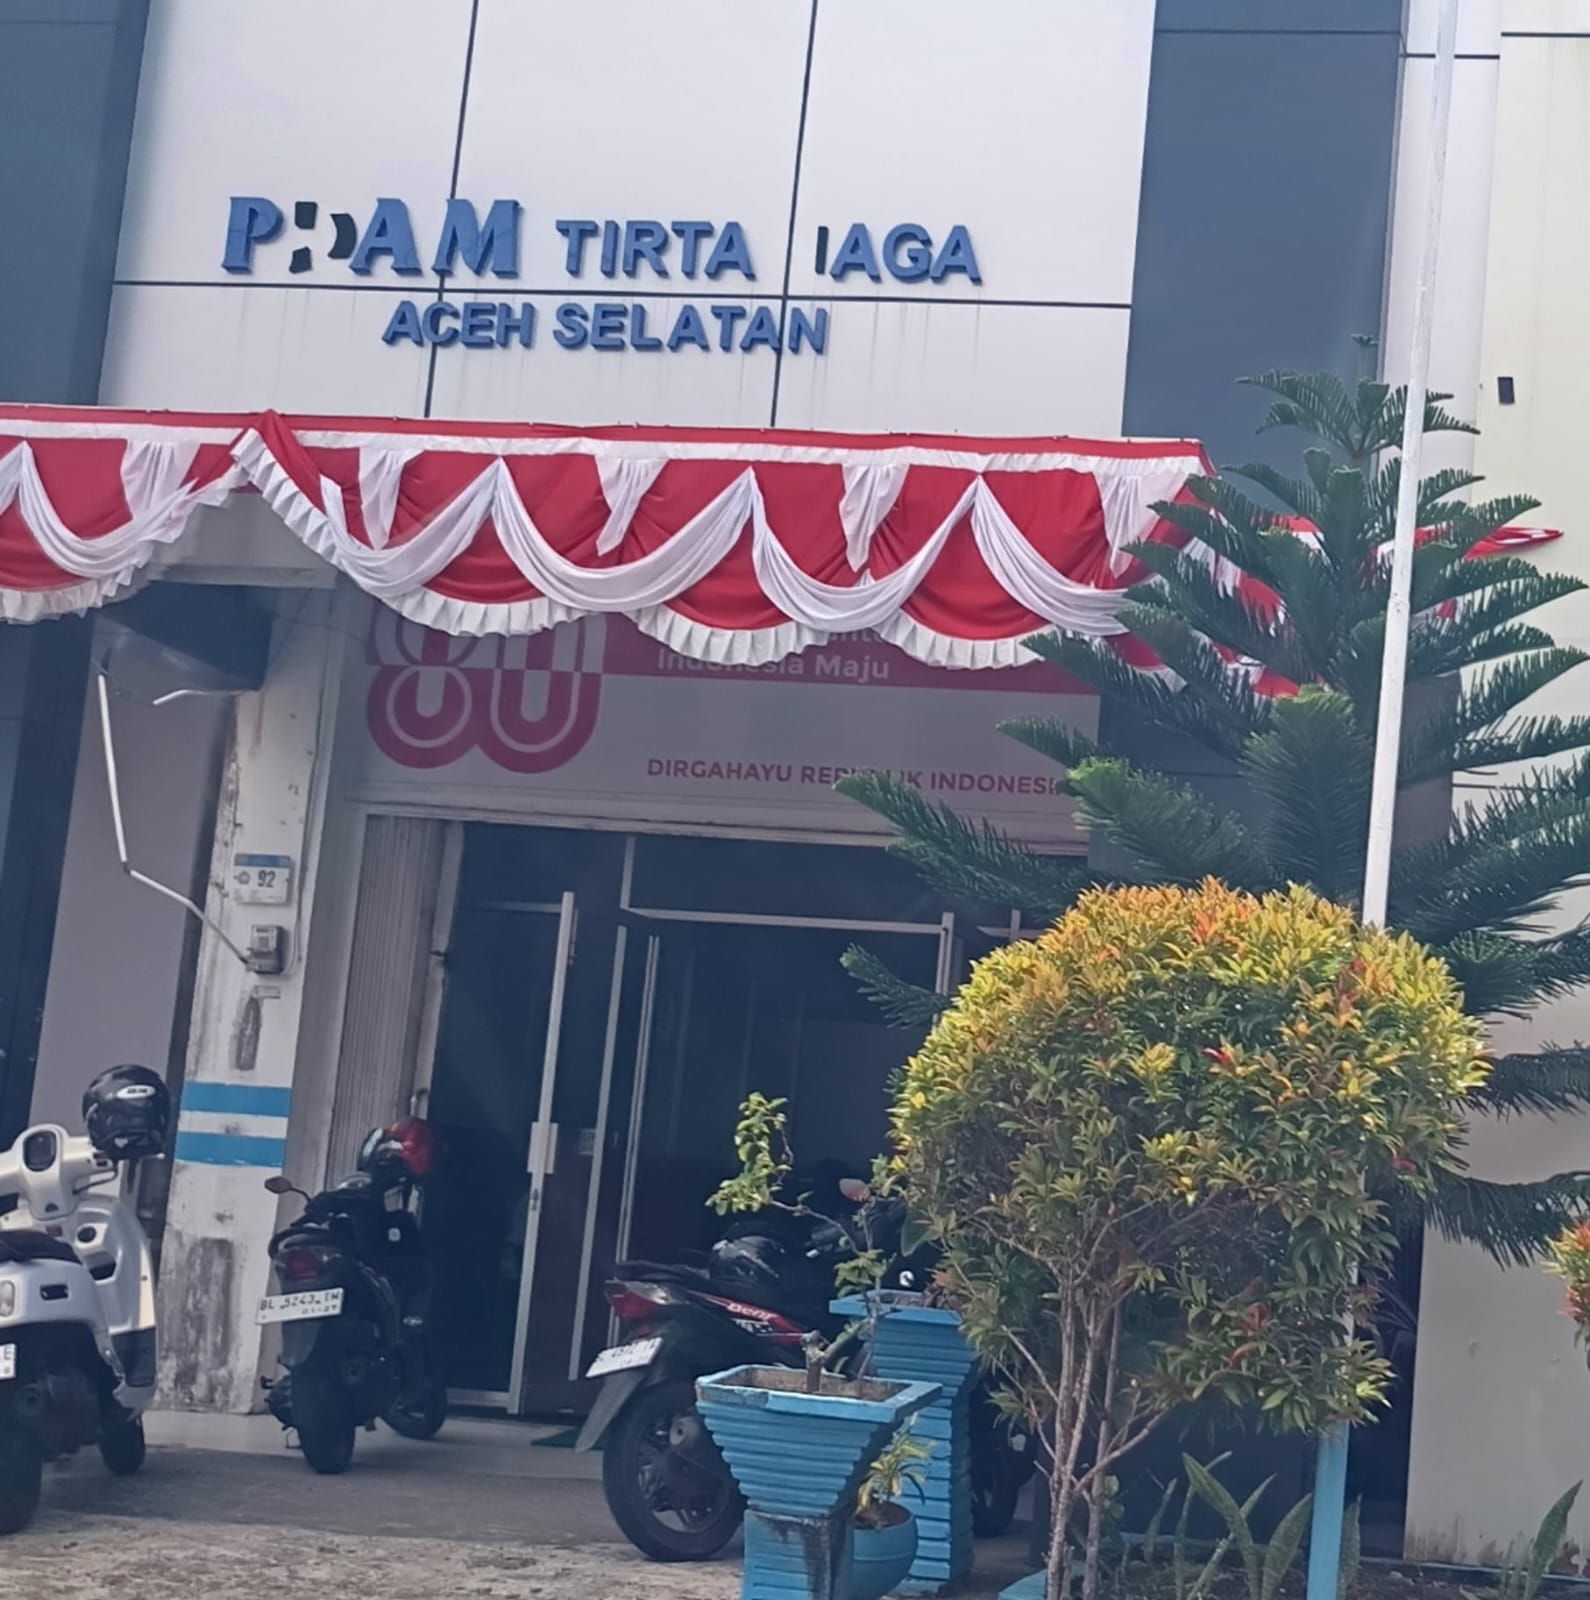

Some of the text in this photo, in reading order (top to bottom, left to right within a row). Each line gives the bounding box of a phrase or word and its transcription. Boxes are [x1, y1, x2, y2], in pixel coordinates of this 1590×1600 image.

[555, 220, 757, 280] TIRTA
[381, 300, 829, 355] ACEH SELATAN
[815, 654, 890, 684] Maju
[647, 758, 793, 783] DIRGAHAYU
[930, 772, 1059, 795] INDONESI
[257, 869, 277, 889] 92
